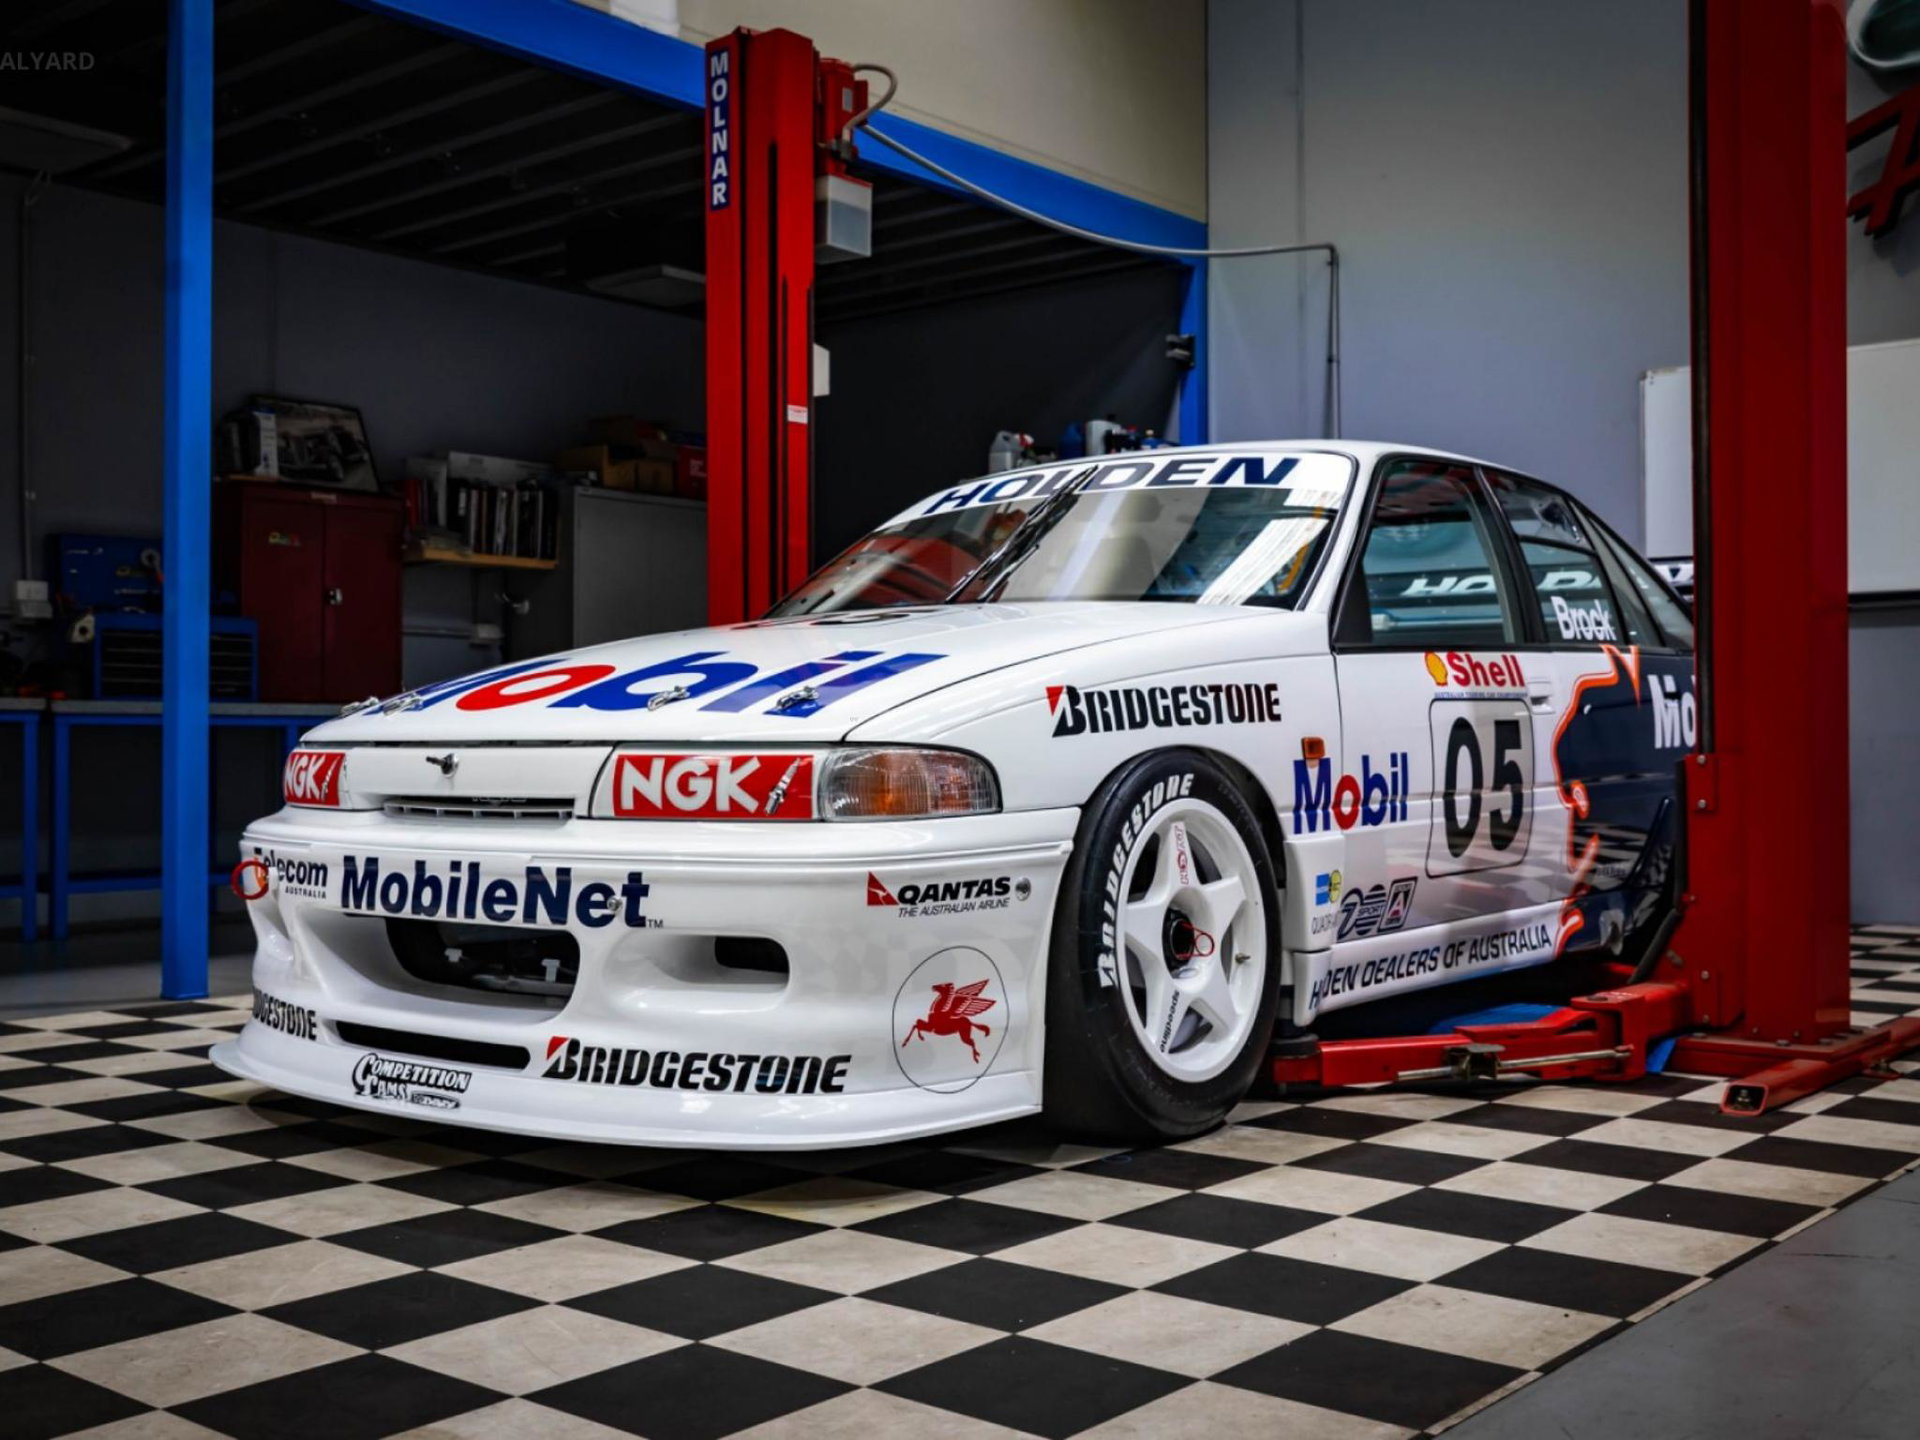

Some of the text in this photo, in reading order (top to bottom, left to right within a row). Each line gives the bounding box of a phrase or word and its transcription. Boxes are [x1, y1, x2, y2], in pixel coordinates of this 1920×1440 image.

[710, 51, 729, 207] MOLNAR
[923, 456, 1301, 515] HOLDEN
[1551, 596, 1617, 641] Brock
[360, 650, 949, 719] Mobil
[1446, 650, 1526, 688] Shell
[1046, 683, 1282, 739] BRIDGESTONE
[283, 754, 327, 800] NGK
[619, 756, 768, 812] NGK
[1293, 752, 1409, 835] Mobil
[1443, 717, 1524, 858] 05
[285, 885, 326, 899] AUSTRALIA
[341, 855, 650, 929] MobileNet
[898, 877, 1011, 905] QANTAS
[899, 897, 1011, 918] THE AUSTRALIAN AIRLINE
[1098, 772, 1195, 989] BRIDGESTONE
[1361, 945, 1441, 989] DEALERS
[1443, 940, 1467, 969] OF
[1467, 923, 1553, 964] AUSTRALIA
[1160, 990, 1180, 1053] speedline
[352, 1052, 472, 1093] COMPETITION
[358, 1073, 407, 1102] CAMS
[541, 1036, 852, 1095] BRIDGESTONE
